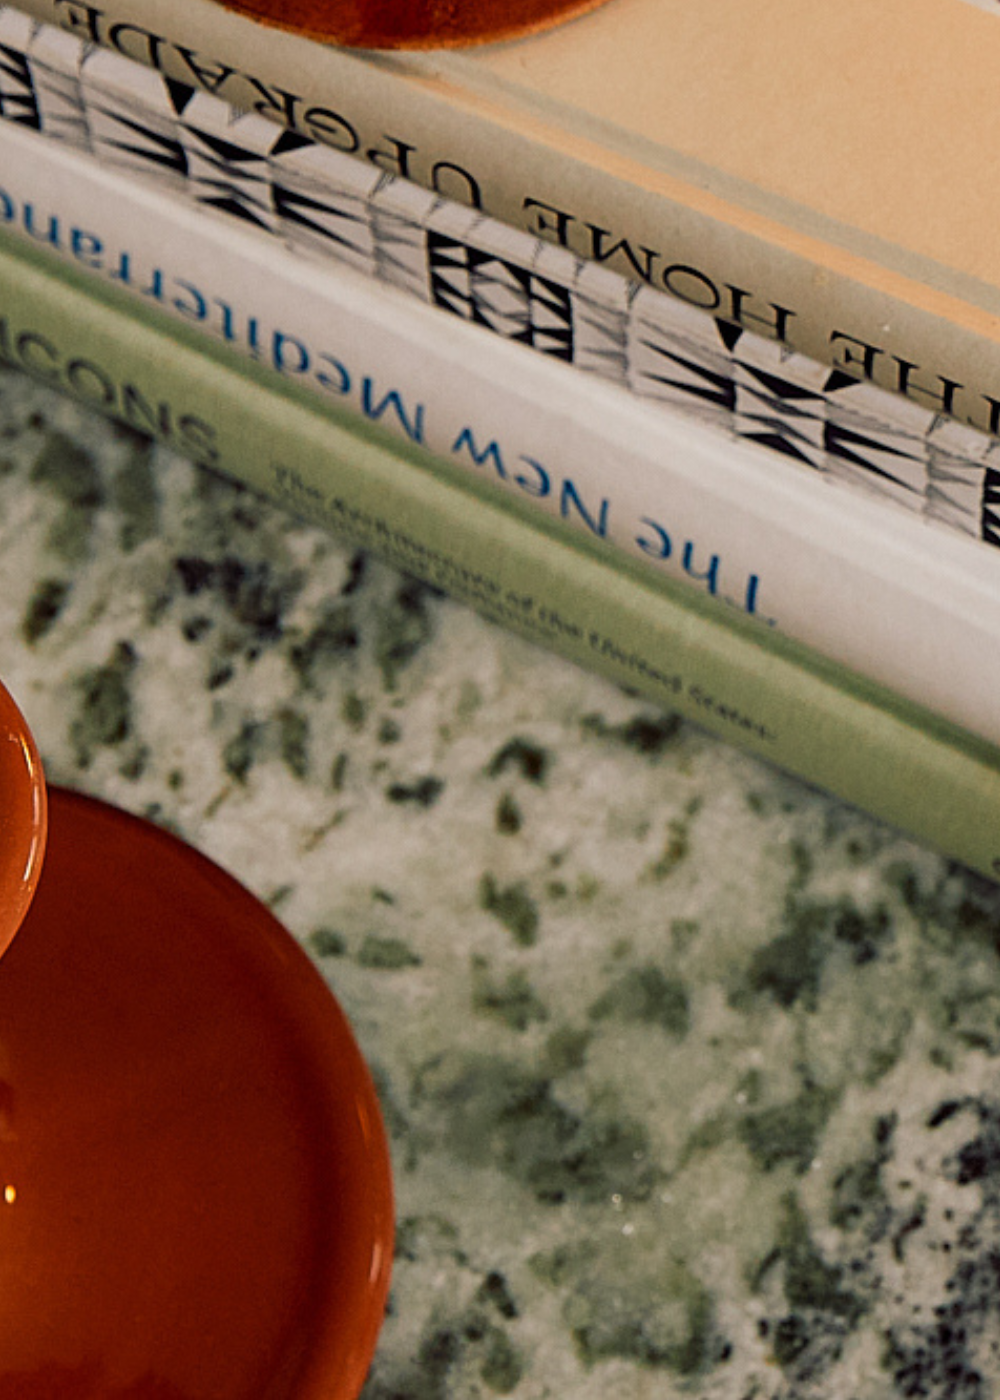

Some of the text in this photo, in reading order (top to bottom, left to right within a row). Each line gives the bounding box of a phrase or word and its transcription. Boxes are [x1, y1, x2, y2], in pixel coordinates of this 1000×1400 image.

[522, 197, 798, 352] HOME
[453, 426, 609, 540] New
[636, 515, 778, 628] The
[588, 630, 683, 693] United
